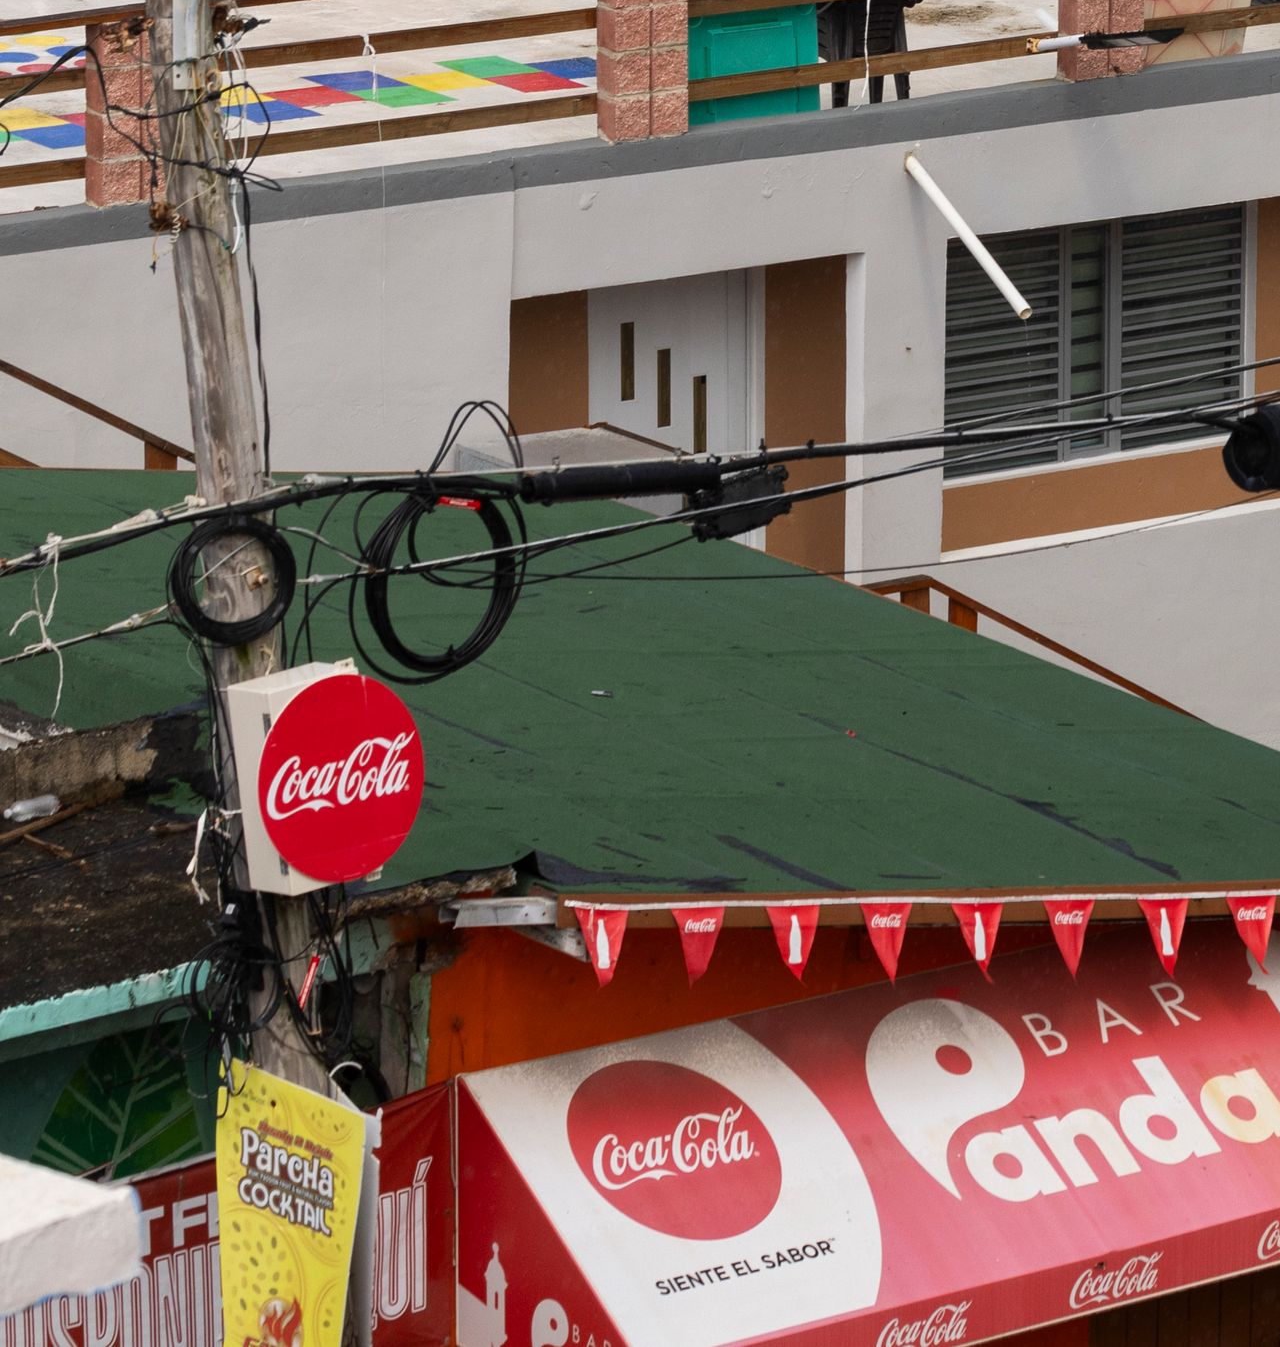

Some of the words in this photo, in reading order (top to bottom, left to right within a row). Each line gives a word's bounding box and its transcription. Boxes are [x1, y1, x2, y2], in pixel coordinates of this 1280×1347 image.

[266, 730, 416, 820] Coca-Cola
[1021, 982, 1201, 1057] BAR
[592, 1105, 755, 1191] Coca-Cola
[239, 1178, 332, 1236] COCKTAIL
[655, 1265, 731, 1297] SIENTE
[735, 1259, 760, 1279] EL
[1069, 1252, 1163, 1309] Coca-Cola
[876, 1300, 973, 1347] Coca-Cola
